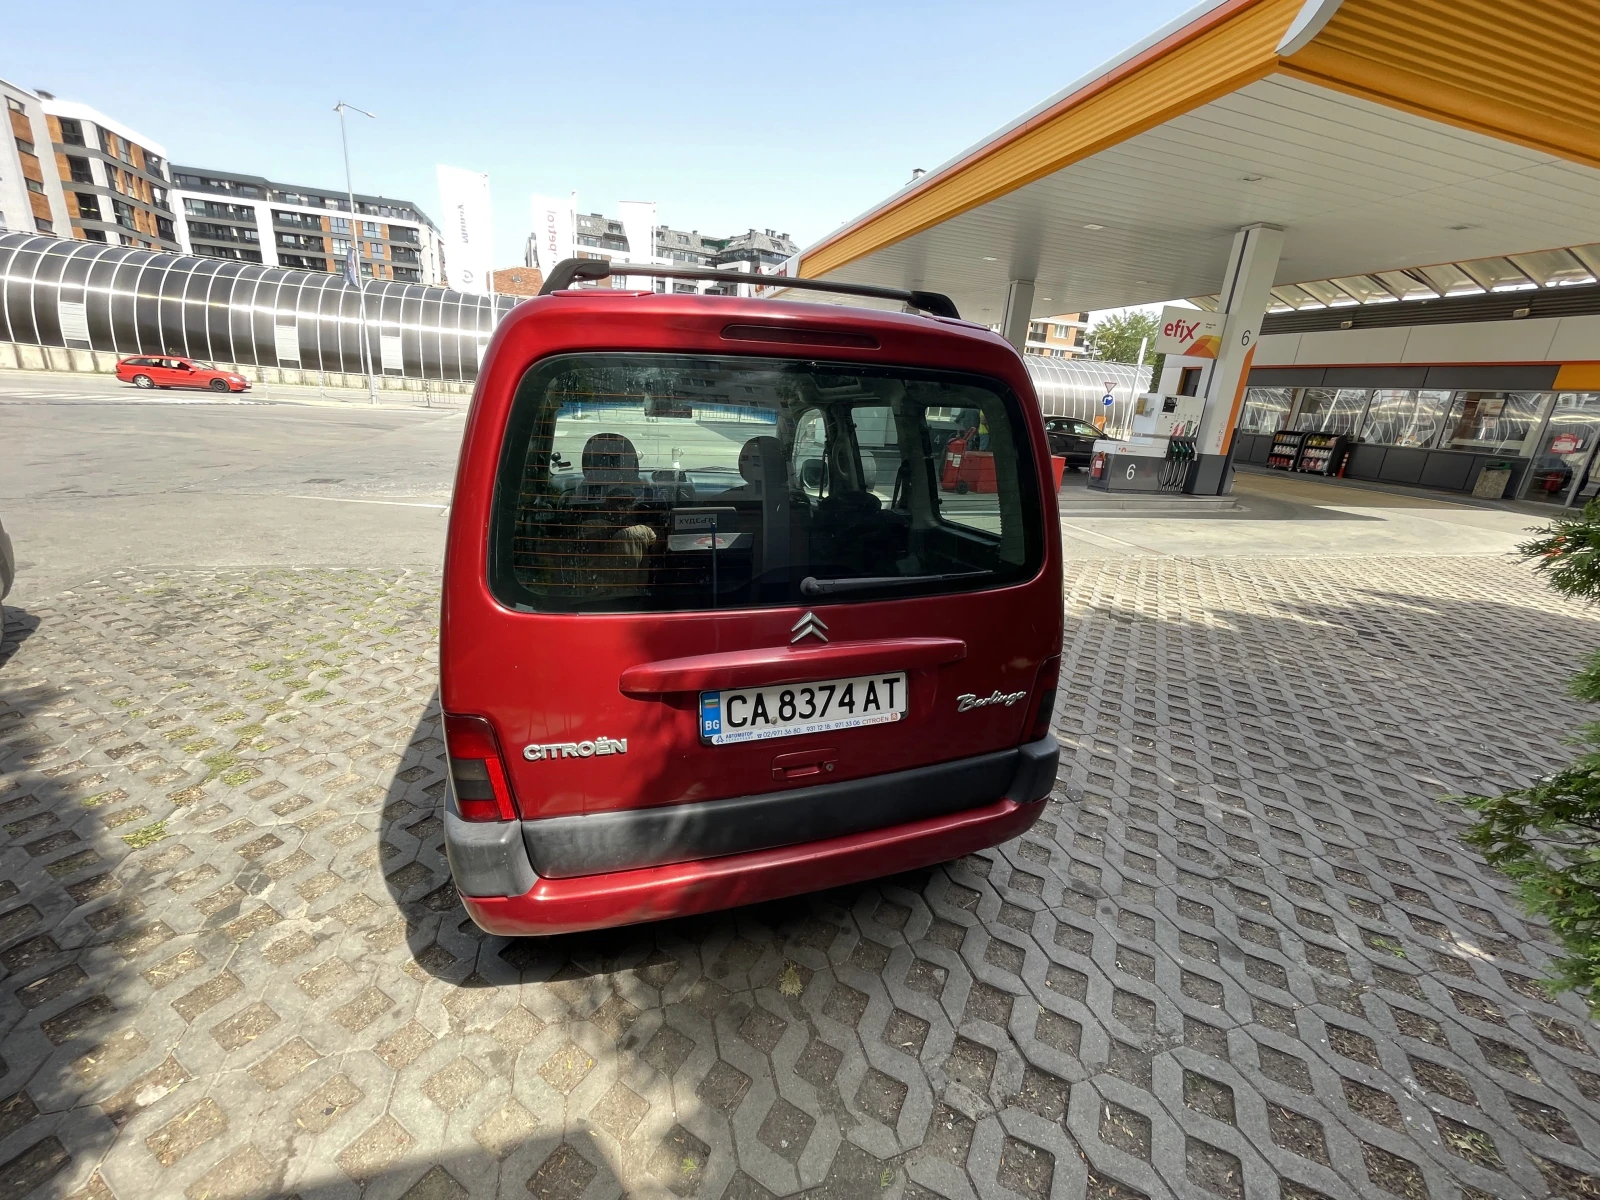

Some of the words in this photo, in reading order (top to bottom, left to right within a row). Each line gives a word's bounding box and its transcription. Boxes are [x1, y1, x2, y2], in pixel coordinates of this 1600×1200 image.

[1163, 318, 1201, 344] efix
[1241, 329, 1252, 346] 6
[1126, 463, 1137, 481] 6
[956, 690, 1027, 713] Berlingo
[705, 719, 720, 731] BG
[523, 736, 628, 761] CITROËN
